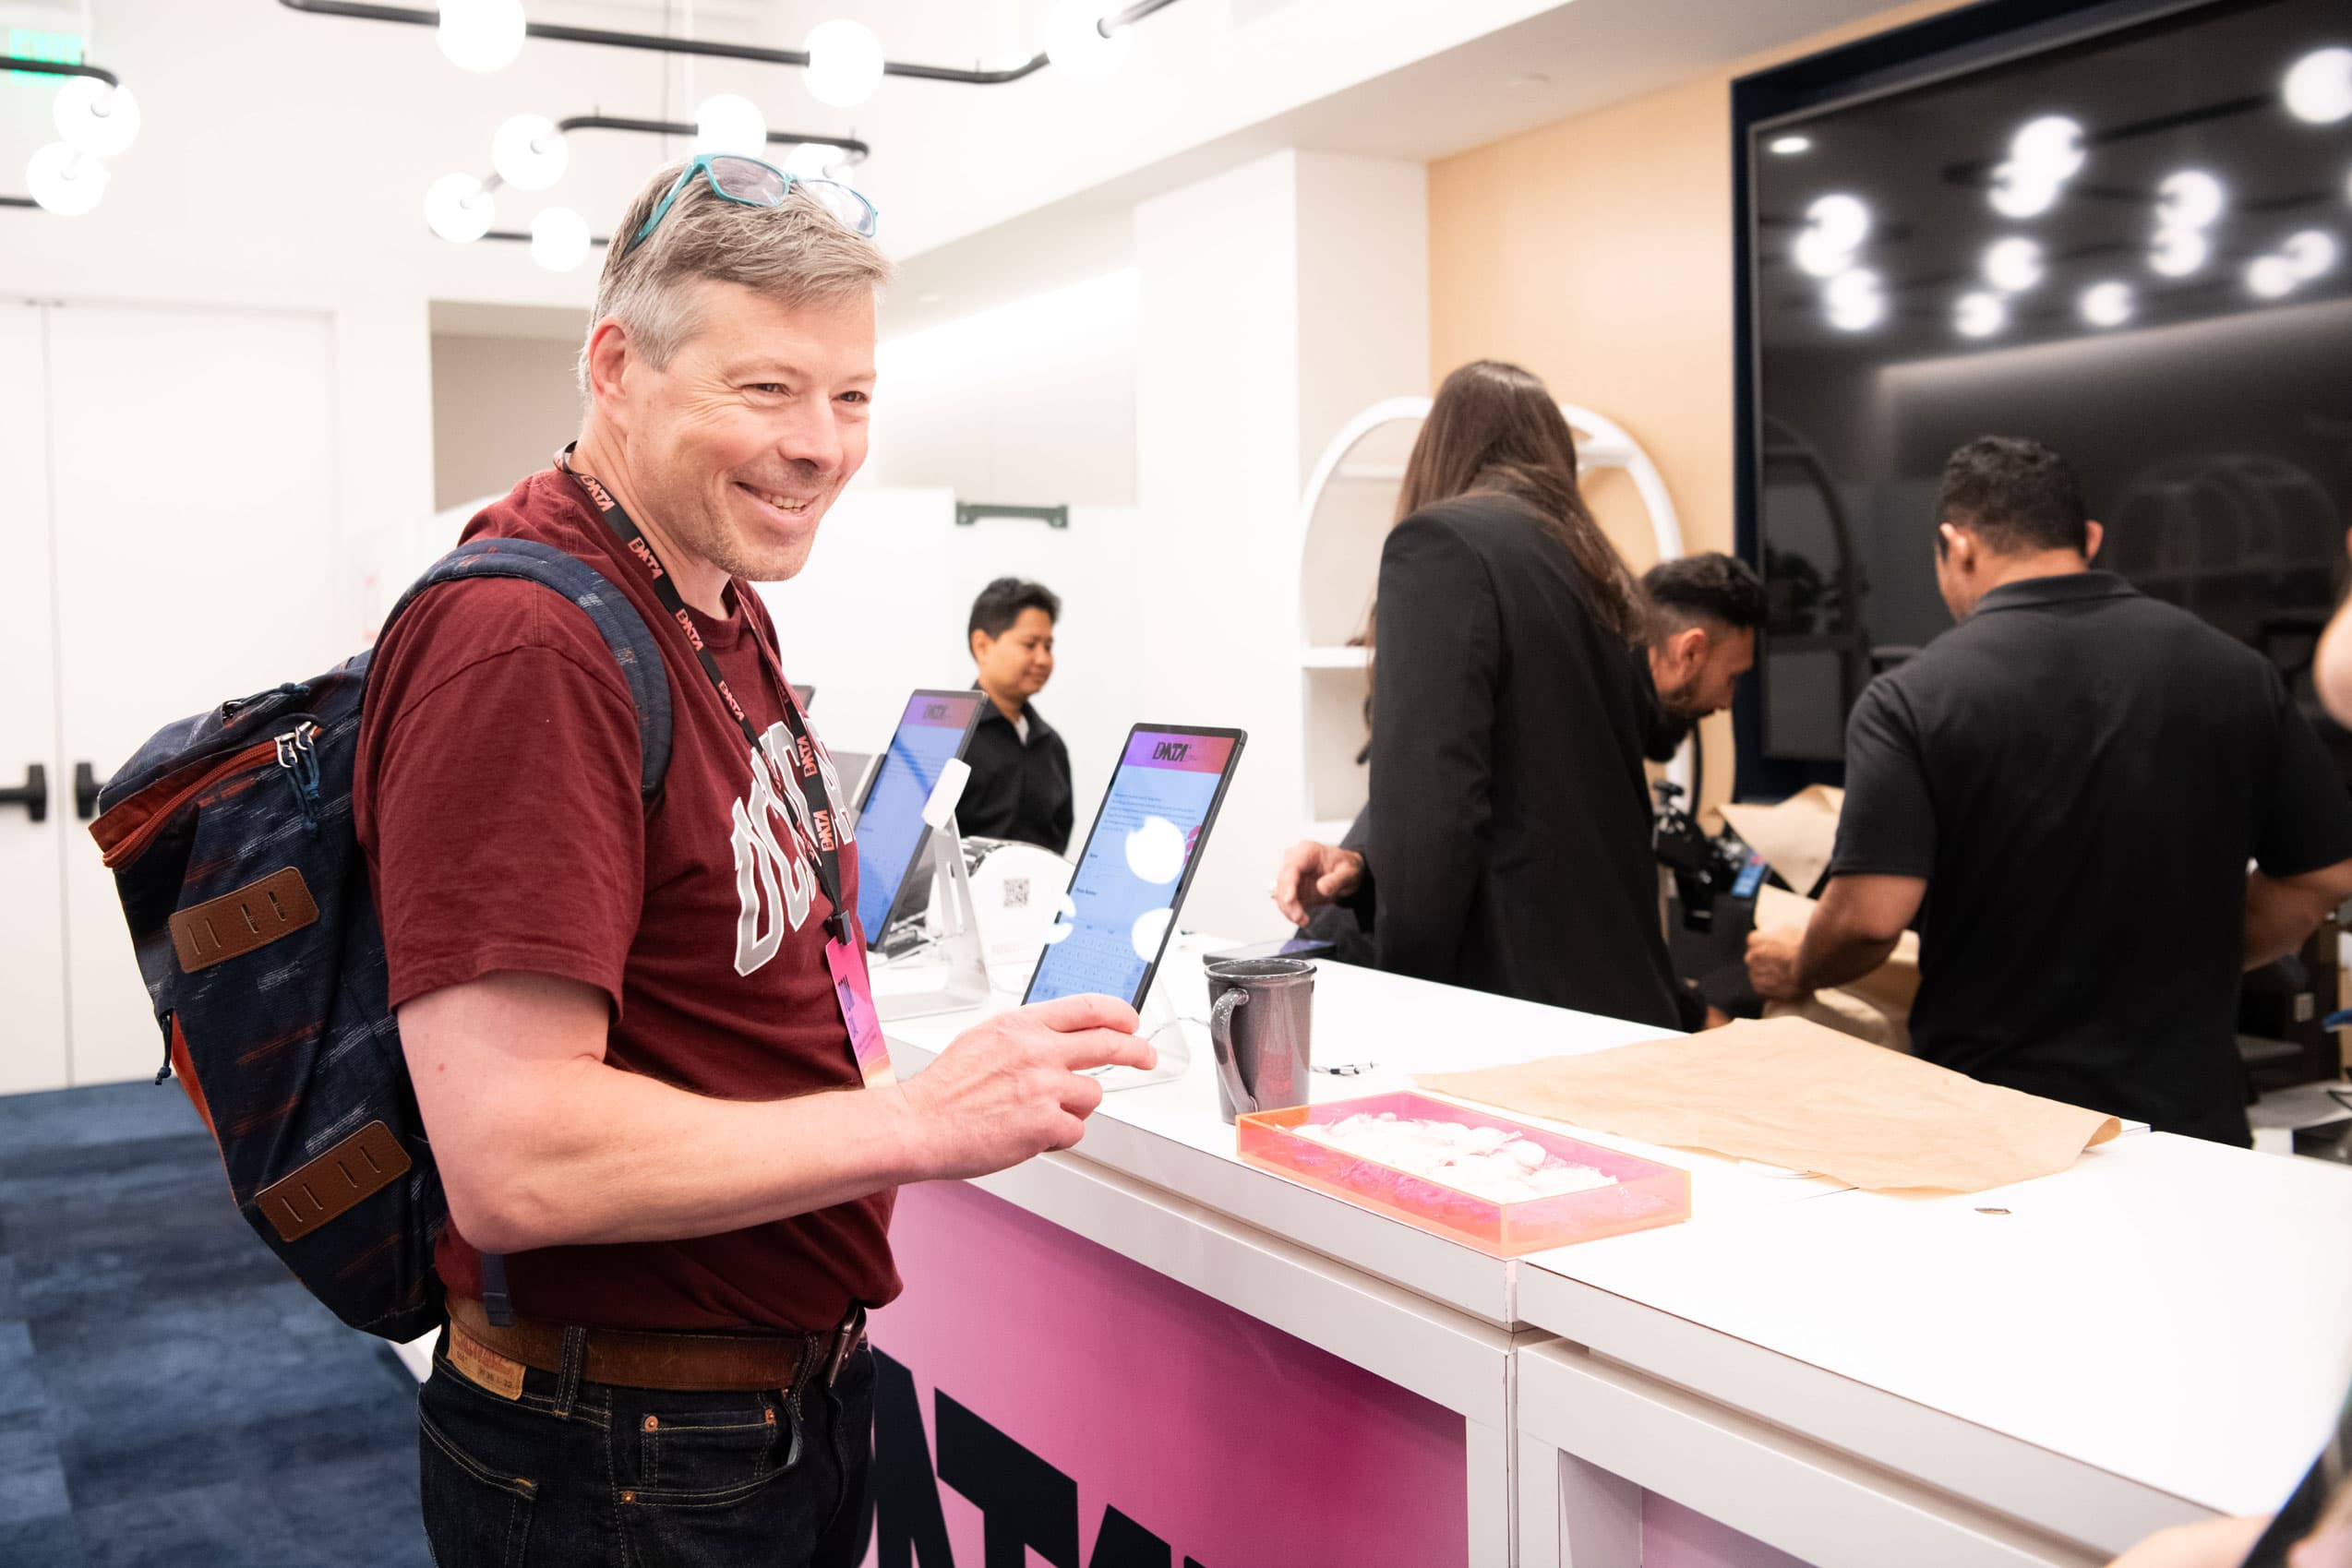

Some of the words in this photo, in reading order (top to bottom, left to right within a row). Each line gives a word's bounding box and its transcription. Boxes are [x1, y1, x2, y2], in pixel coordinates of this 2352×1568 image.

[579, 474, 616, 512] DATA
[628, 536, 664, 580] DATA
[675, 608, 703, 652] DATA
[718, 680, 745, 721] DATA
[797, 736, 818, 777] DATA
[1152, 741, 1189, 762] DATA
[812, 809, 834, 852] DATA
